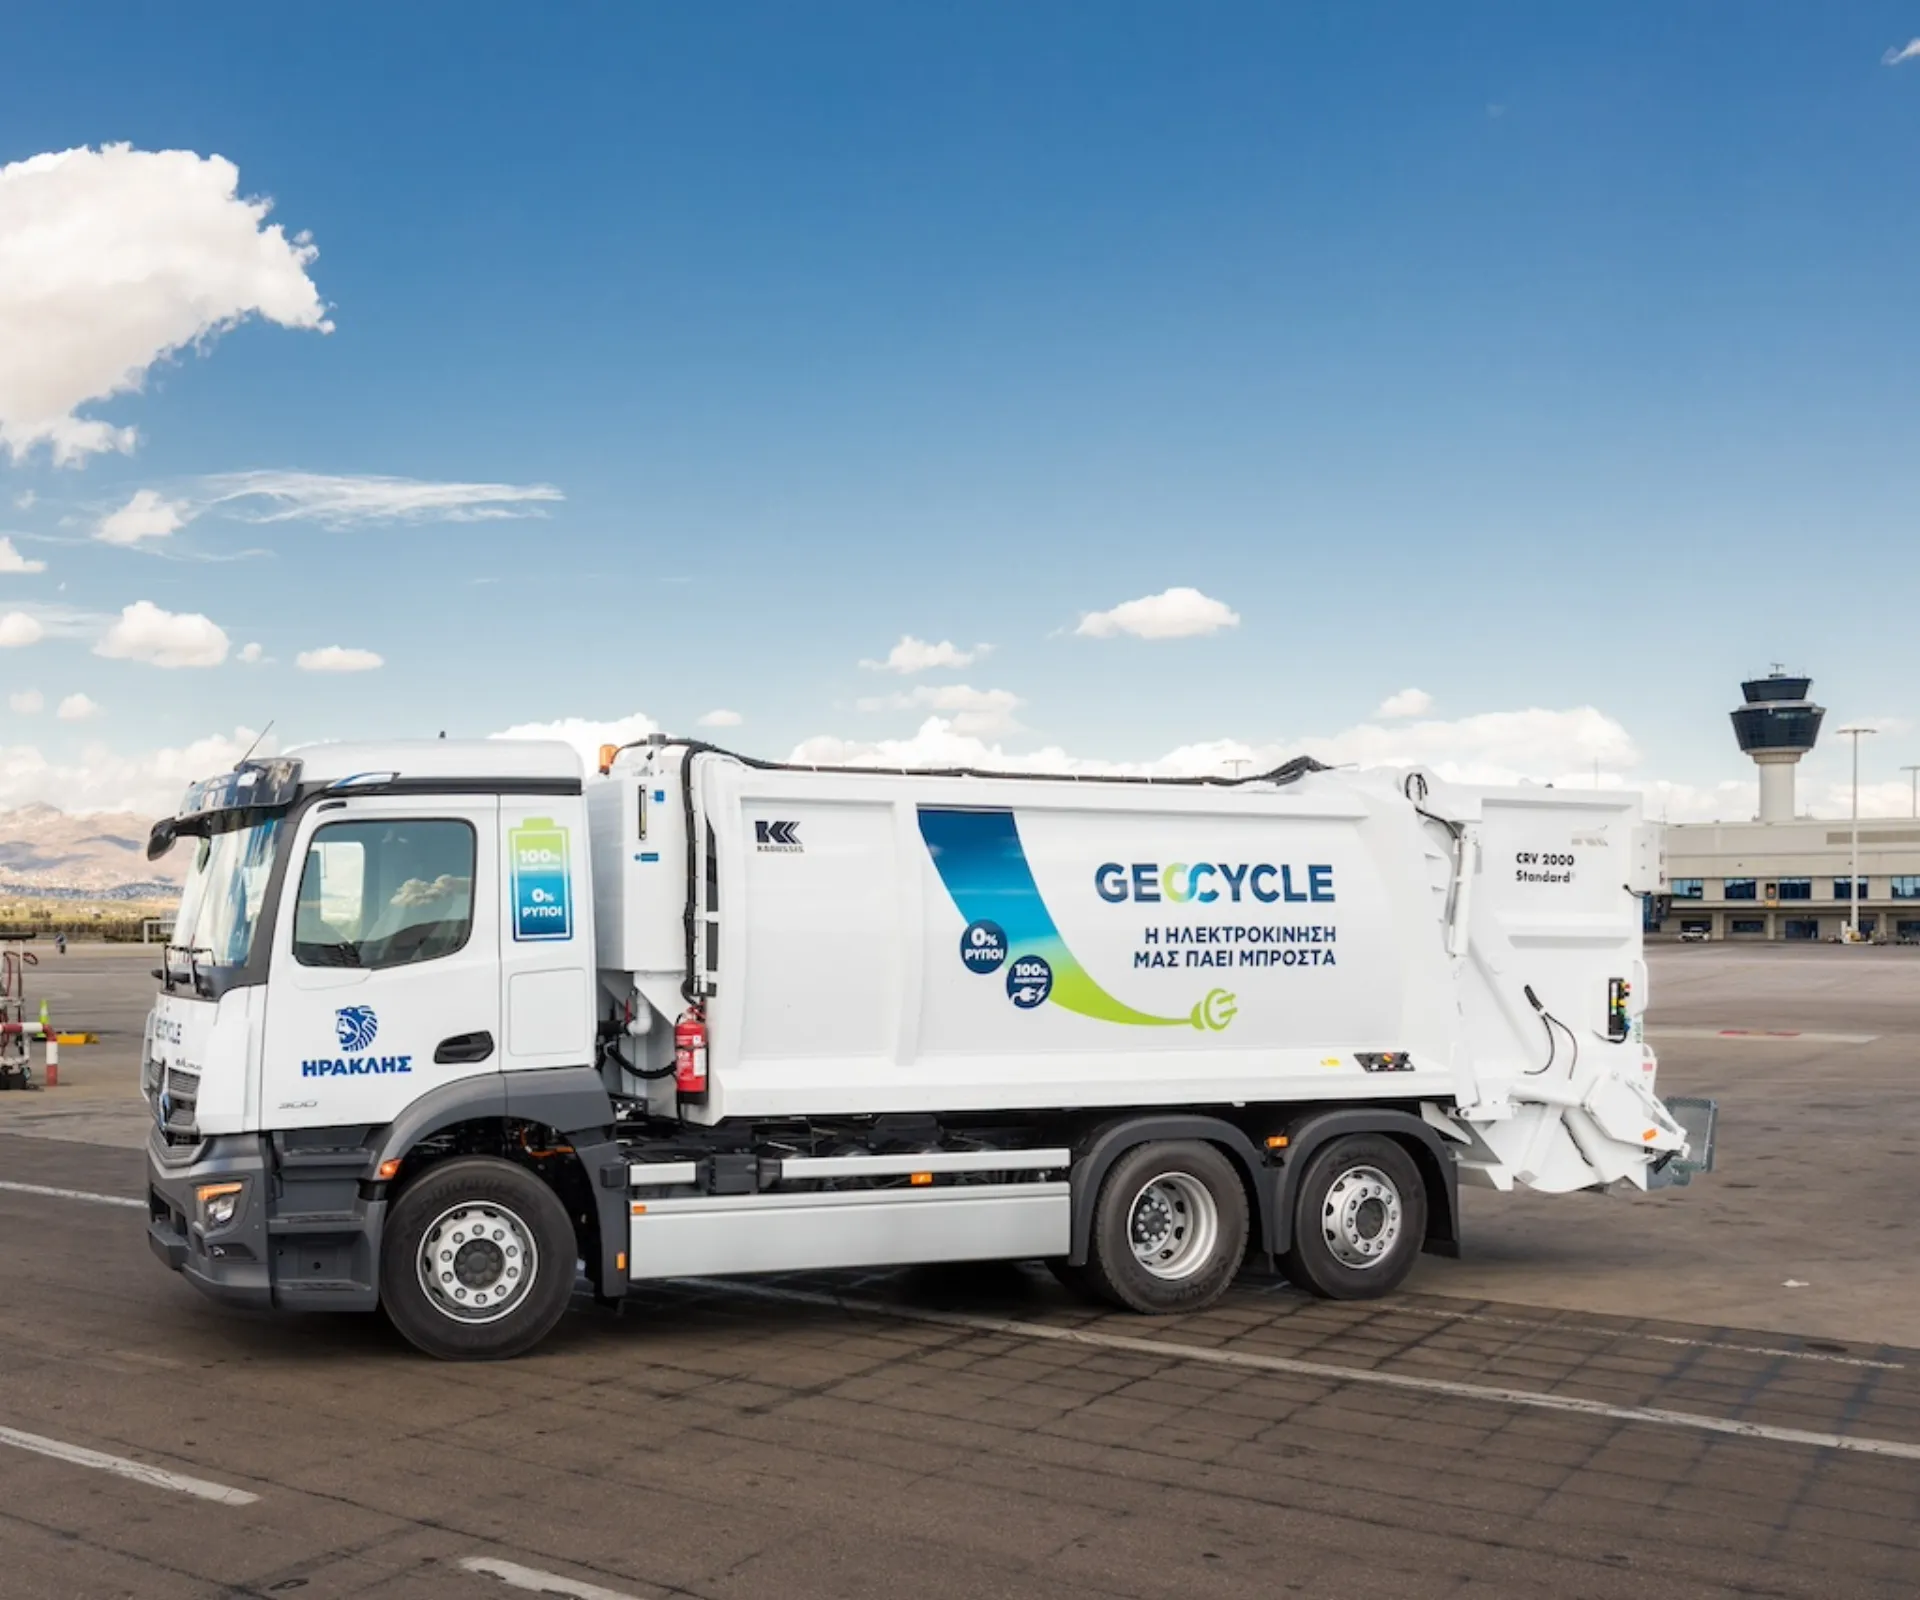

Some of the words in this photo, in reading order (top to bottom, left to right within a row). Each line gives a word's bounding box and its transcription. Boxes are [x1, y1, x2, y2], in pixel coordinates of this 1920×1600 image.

[1516, 852, 1539, 864] CRV
[1542, 853, 1575, 866] 2000
[1094, 862, 1336, 903] GEOCYCLE
[1516, 869, 1571, 883] Standard
[531, 888, 555, 903] 0%
[522, 906, 563, 917] ΡΥΠΟΙ
[971, 927, 998, 946] 0%
[1145, 926, 1159, 944] Η
[1165, 926, 1337, 944] ΗΛΕΚΤΡΟΚΙΝΗΣΗ
[964, 948, 1004, 960] ΡΥΠΟΙ
[1133, 950, 1180, 968] ΜΑΣ
[1185, 949, 1233, 967] ΠΑΕΙ
[1239, 949, 1337, 967] ΜΠΡΟΣΤΑ
[1014, 963, 1049, 977] 100%
[302, 1056, 412, 1077] ΗΡΑΚΛΗΣ
